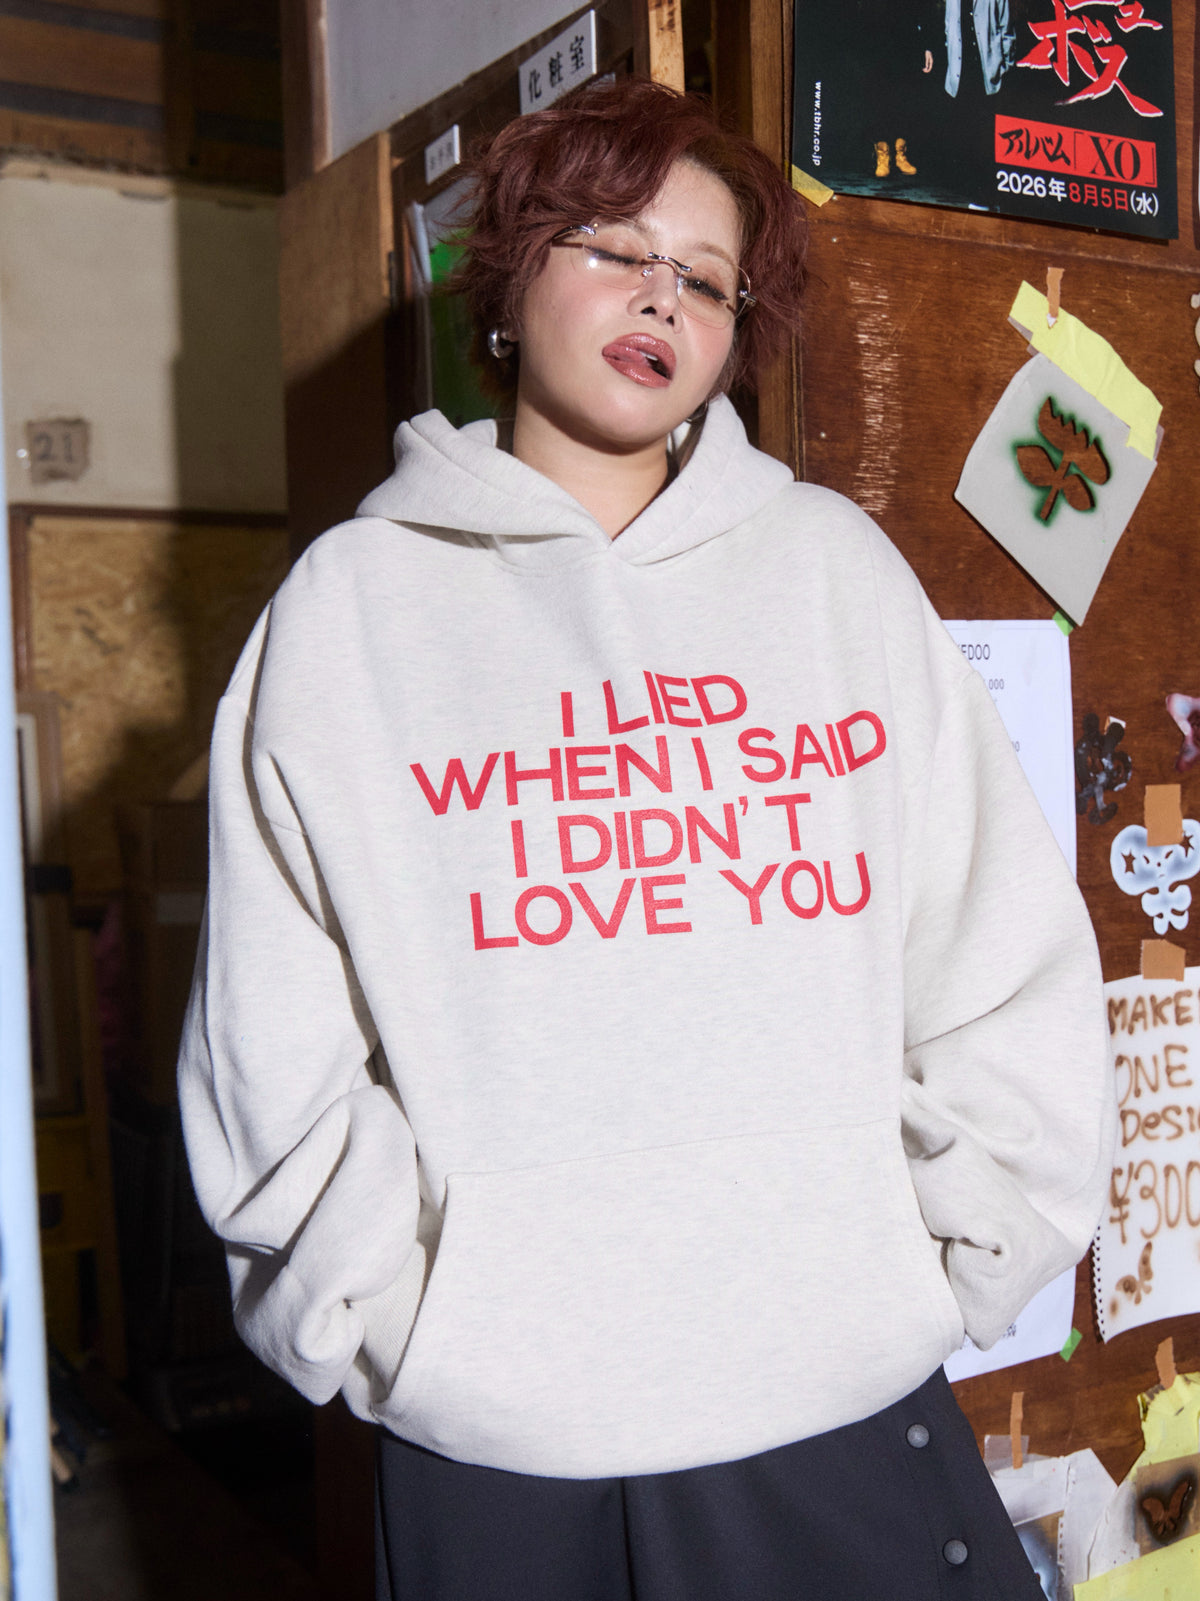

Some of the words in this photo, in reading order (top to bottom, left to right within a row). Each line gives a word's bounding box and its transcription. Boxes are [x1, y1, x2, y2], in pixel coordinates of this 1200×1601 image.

[528, 35, 585, 103] 化粧室
[812, 81, 822, 166] www.tbhr.co.jp
[561, 692, 574, 737] I
[602, 670, 747, 735] LIED
[410, 735, 672, 816] WHEN
[691, 737, 713, 791] I
[738, 710, 886, 783] SAID
[511, 820, 528, 878] I
[557, 793, 811, 874] DIDN'T
[470, 874, 692, 950] LOVE
[718, 852, 871, 925] YOU
